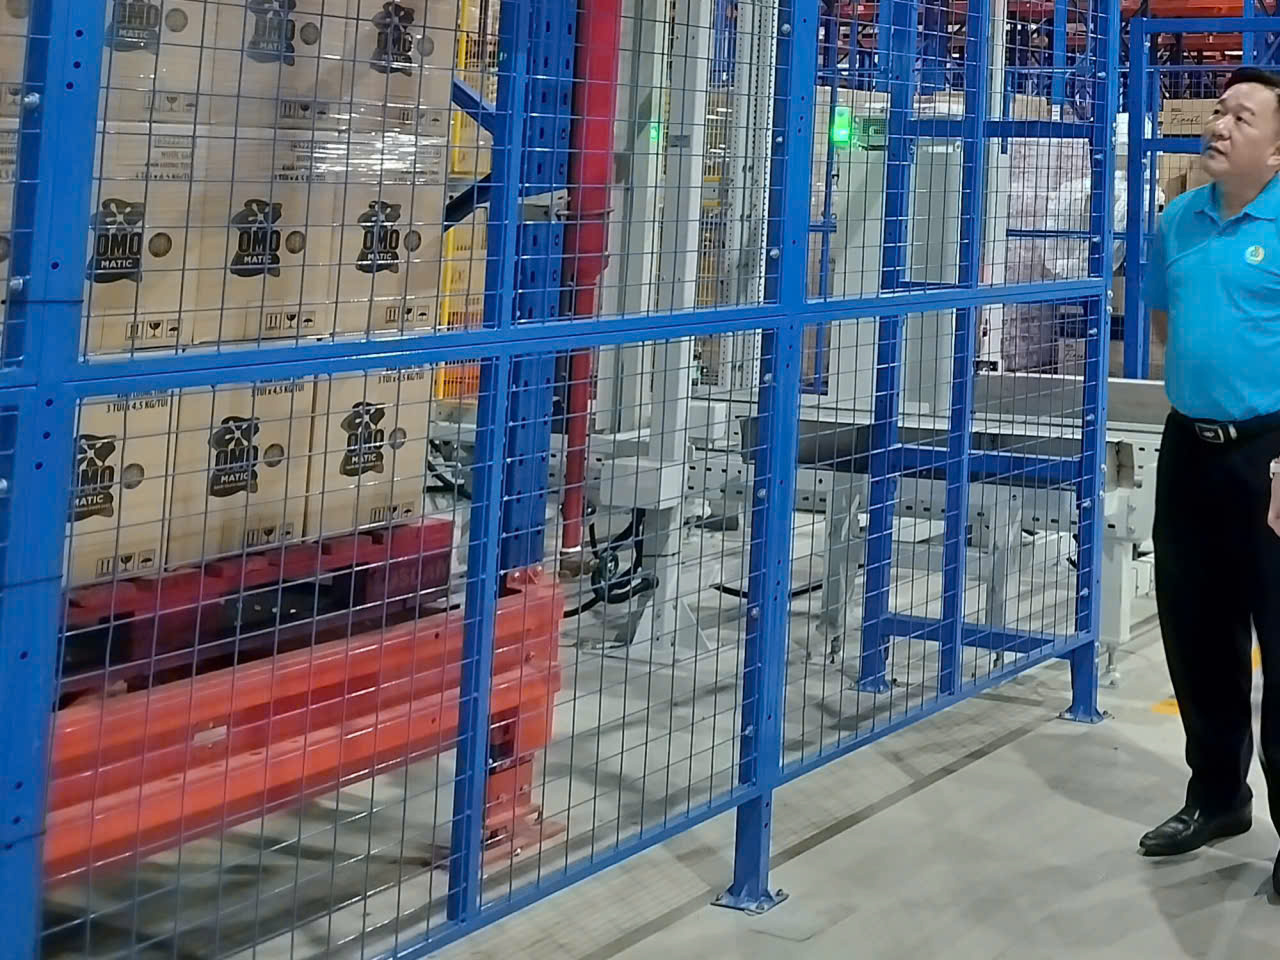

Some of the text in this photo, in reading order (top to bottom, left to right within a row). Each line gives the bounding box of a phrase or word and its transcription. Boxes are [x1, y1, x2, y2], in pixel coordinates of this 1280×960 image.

[118, 29, 149, 39] MATIC
[96, 232, 142, 258] OMO
[238, 229, 282, 254] OMO
[362, 228, 400, 251] OMO
[244, 255, 272, 264] MATIC
[368, 252, 392, 261] MATIC
[101, 259, 133, 269] MATIC
[106, 404, 111, 413] 3
[347, 429, 385, 453] OMO
[215, 445, 259, 473] OMO
[351, 454, 377, 464] MATIC
[80, 464, 115, 494] MO
[221, 472, 249, 484] MATIC
